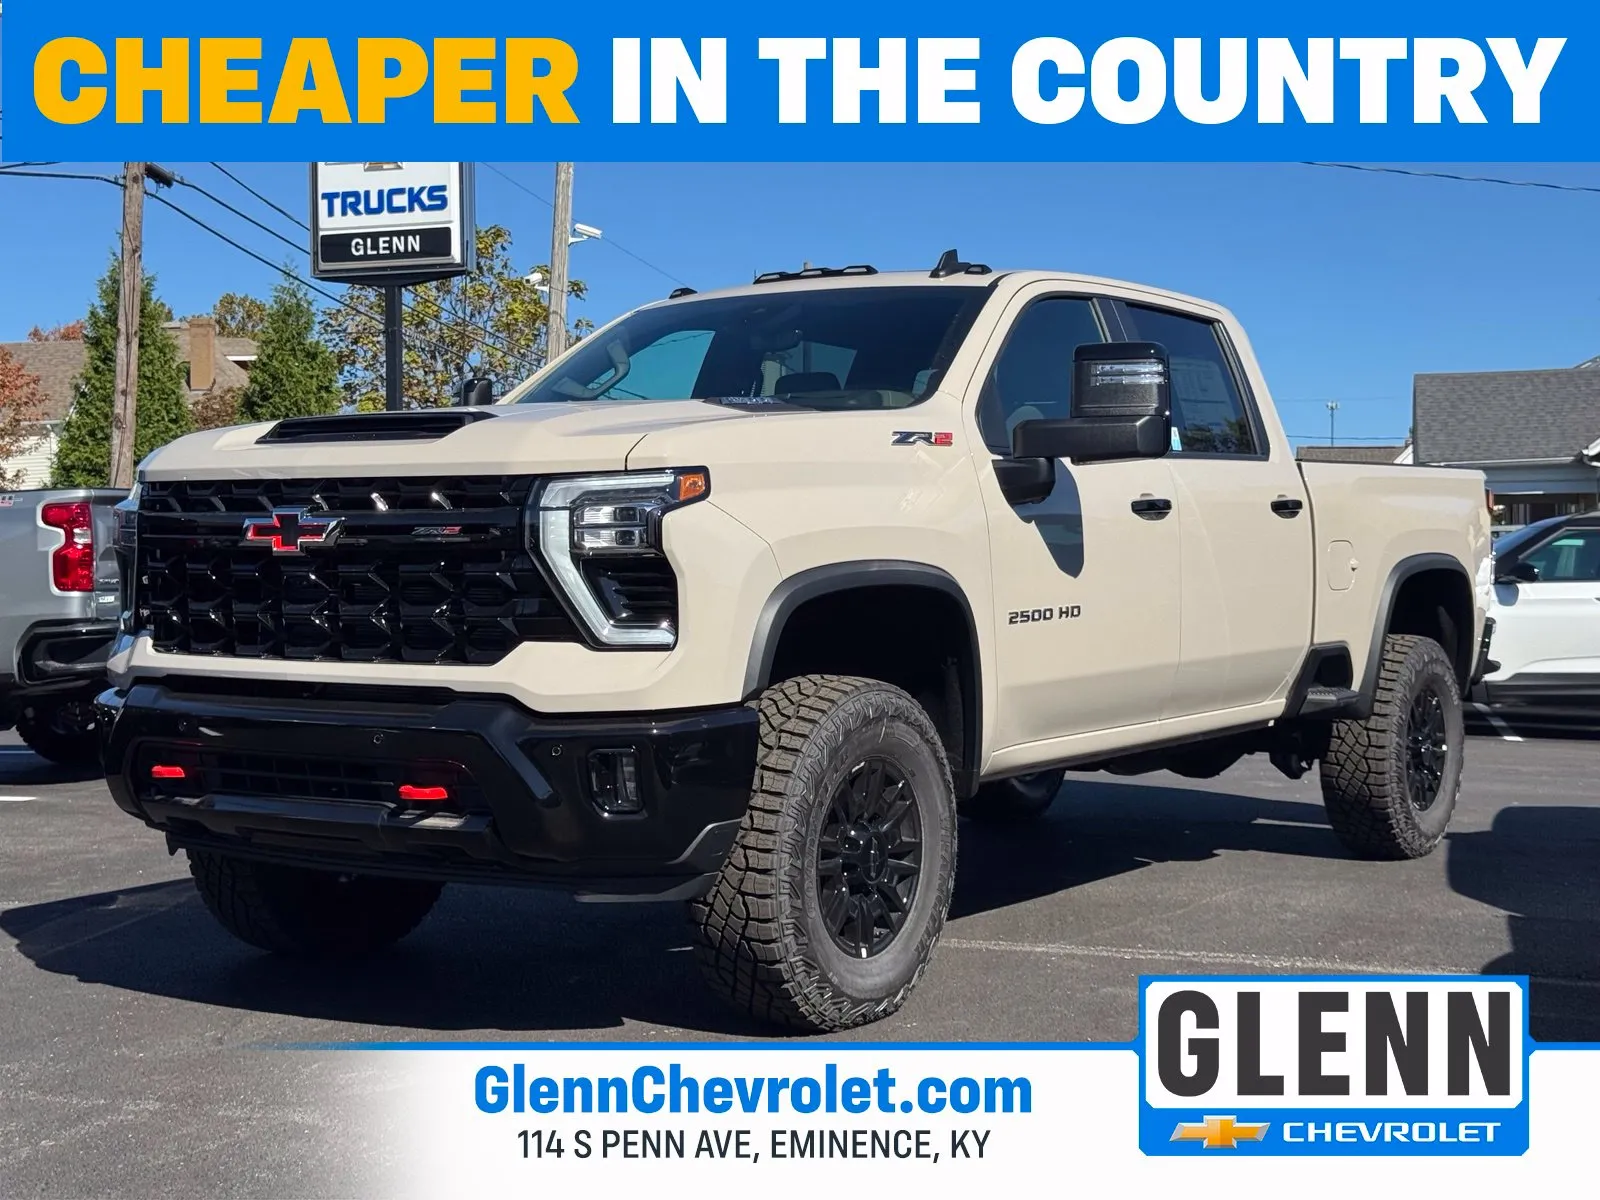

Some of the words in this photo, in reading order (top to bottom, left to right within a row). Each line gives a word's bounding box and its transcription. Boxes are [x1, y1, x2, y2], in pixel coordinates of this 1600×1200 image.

[321, 185, 448, 218] TRUCKS
[351, 234, 421, 256] GLENN
[891, 431, 953, 447] ZR2
[1008, 607, 1054, 625] 2500
[1058, 605, 1081, 620] HD
